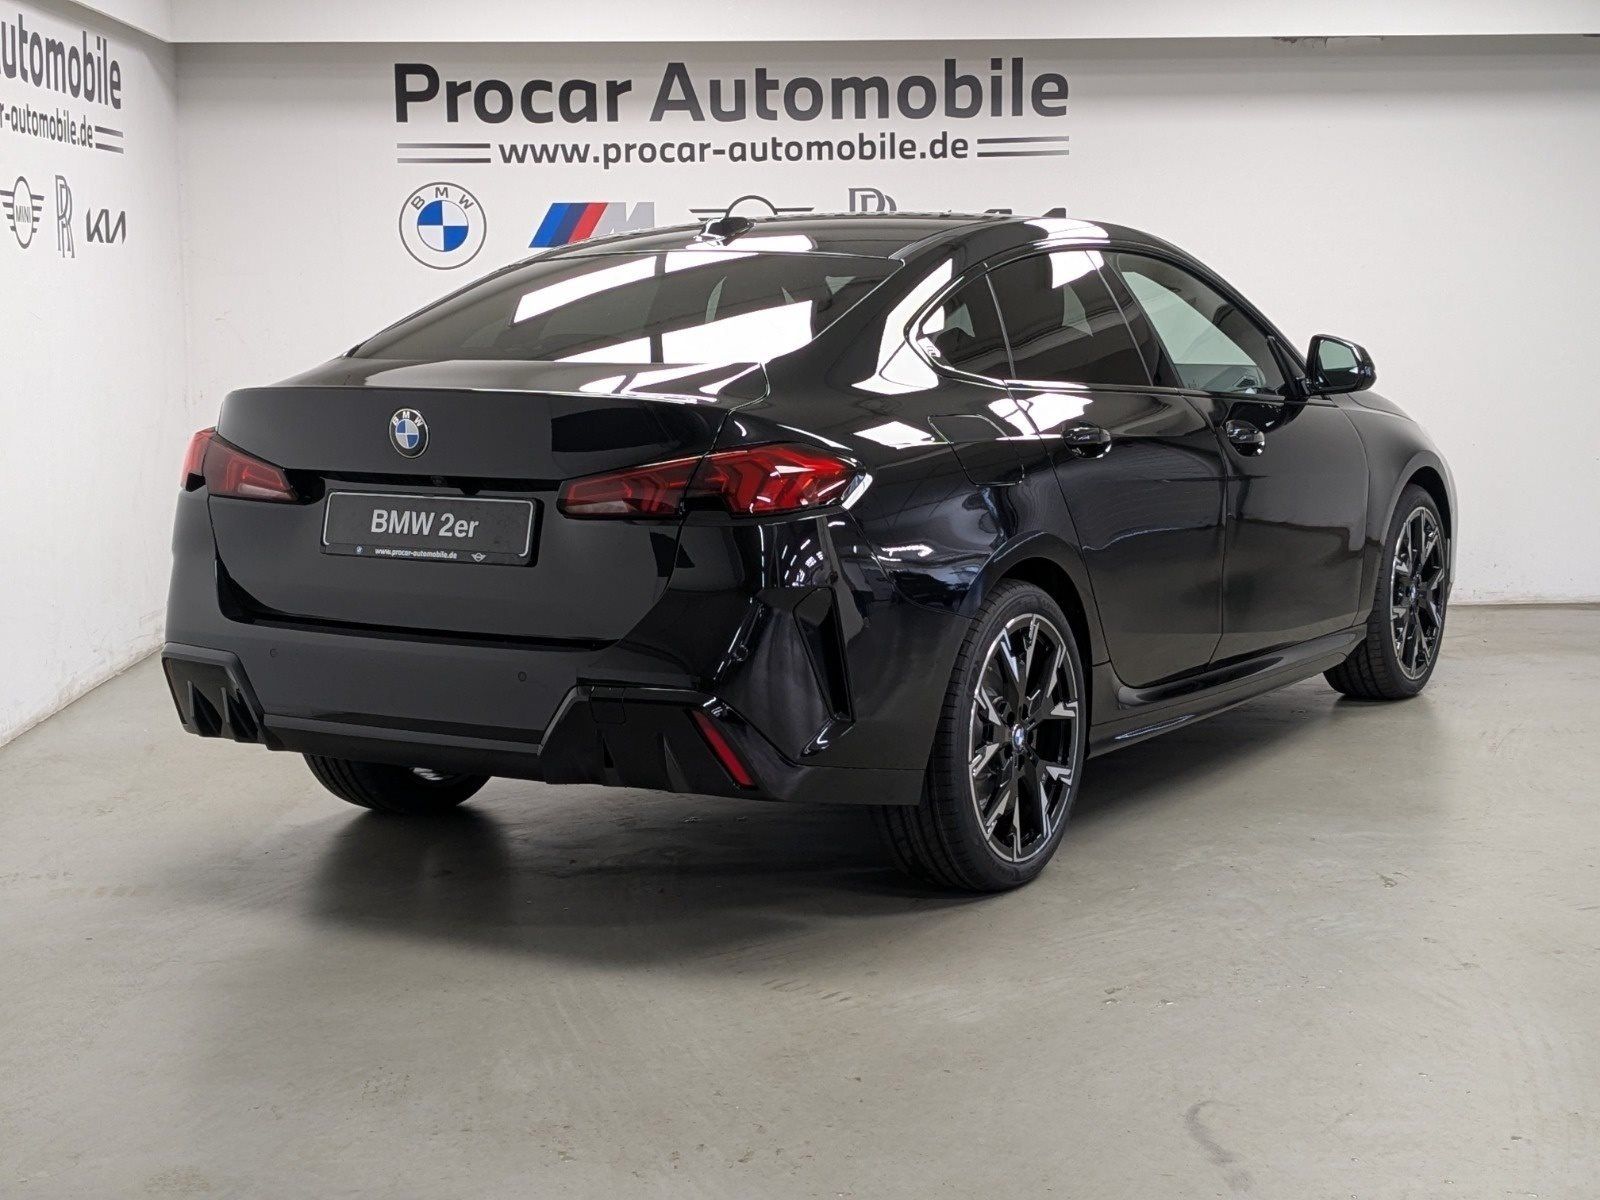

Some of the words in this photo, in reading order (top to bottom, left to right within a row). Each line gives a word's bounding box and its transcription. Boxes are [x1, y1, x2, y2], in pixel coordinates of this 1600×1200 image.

[0, 13, 121, 109] utomobile
[394, 63, 632, 124] Procar
[650, 57, 1069, 122] Automobile
[498, 131, 969, 169] www.procar-automobile.de
[410, 186, 474, 211] BMW
[15, 205, 31, 223] MINI
[392, 411, 424, 427] BMW
[370, 509, 435, 536] BMW
[438, 512, 479, 538] 2er
[375, 548, 458, 560] www.procar-automobile.de
